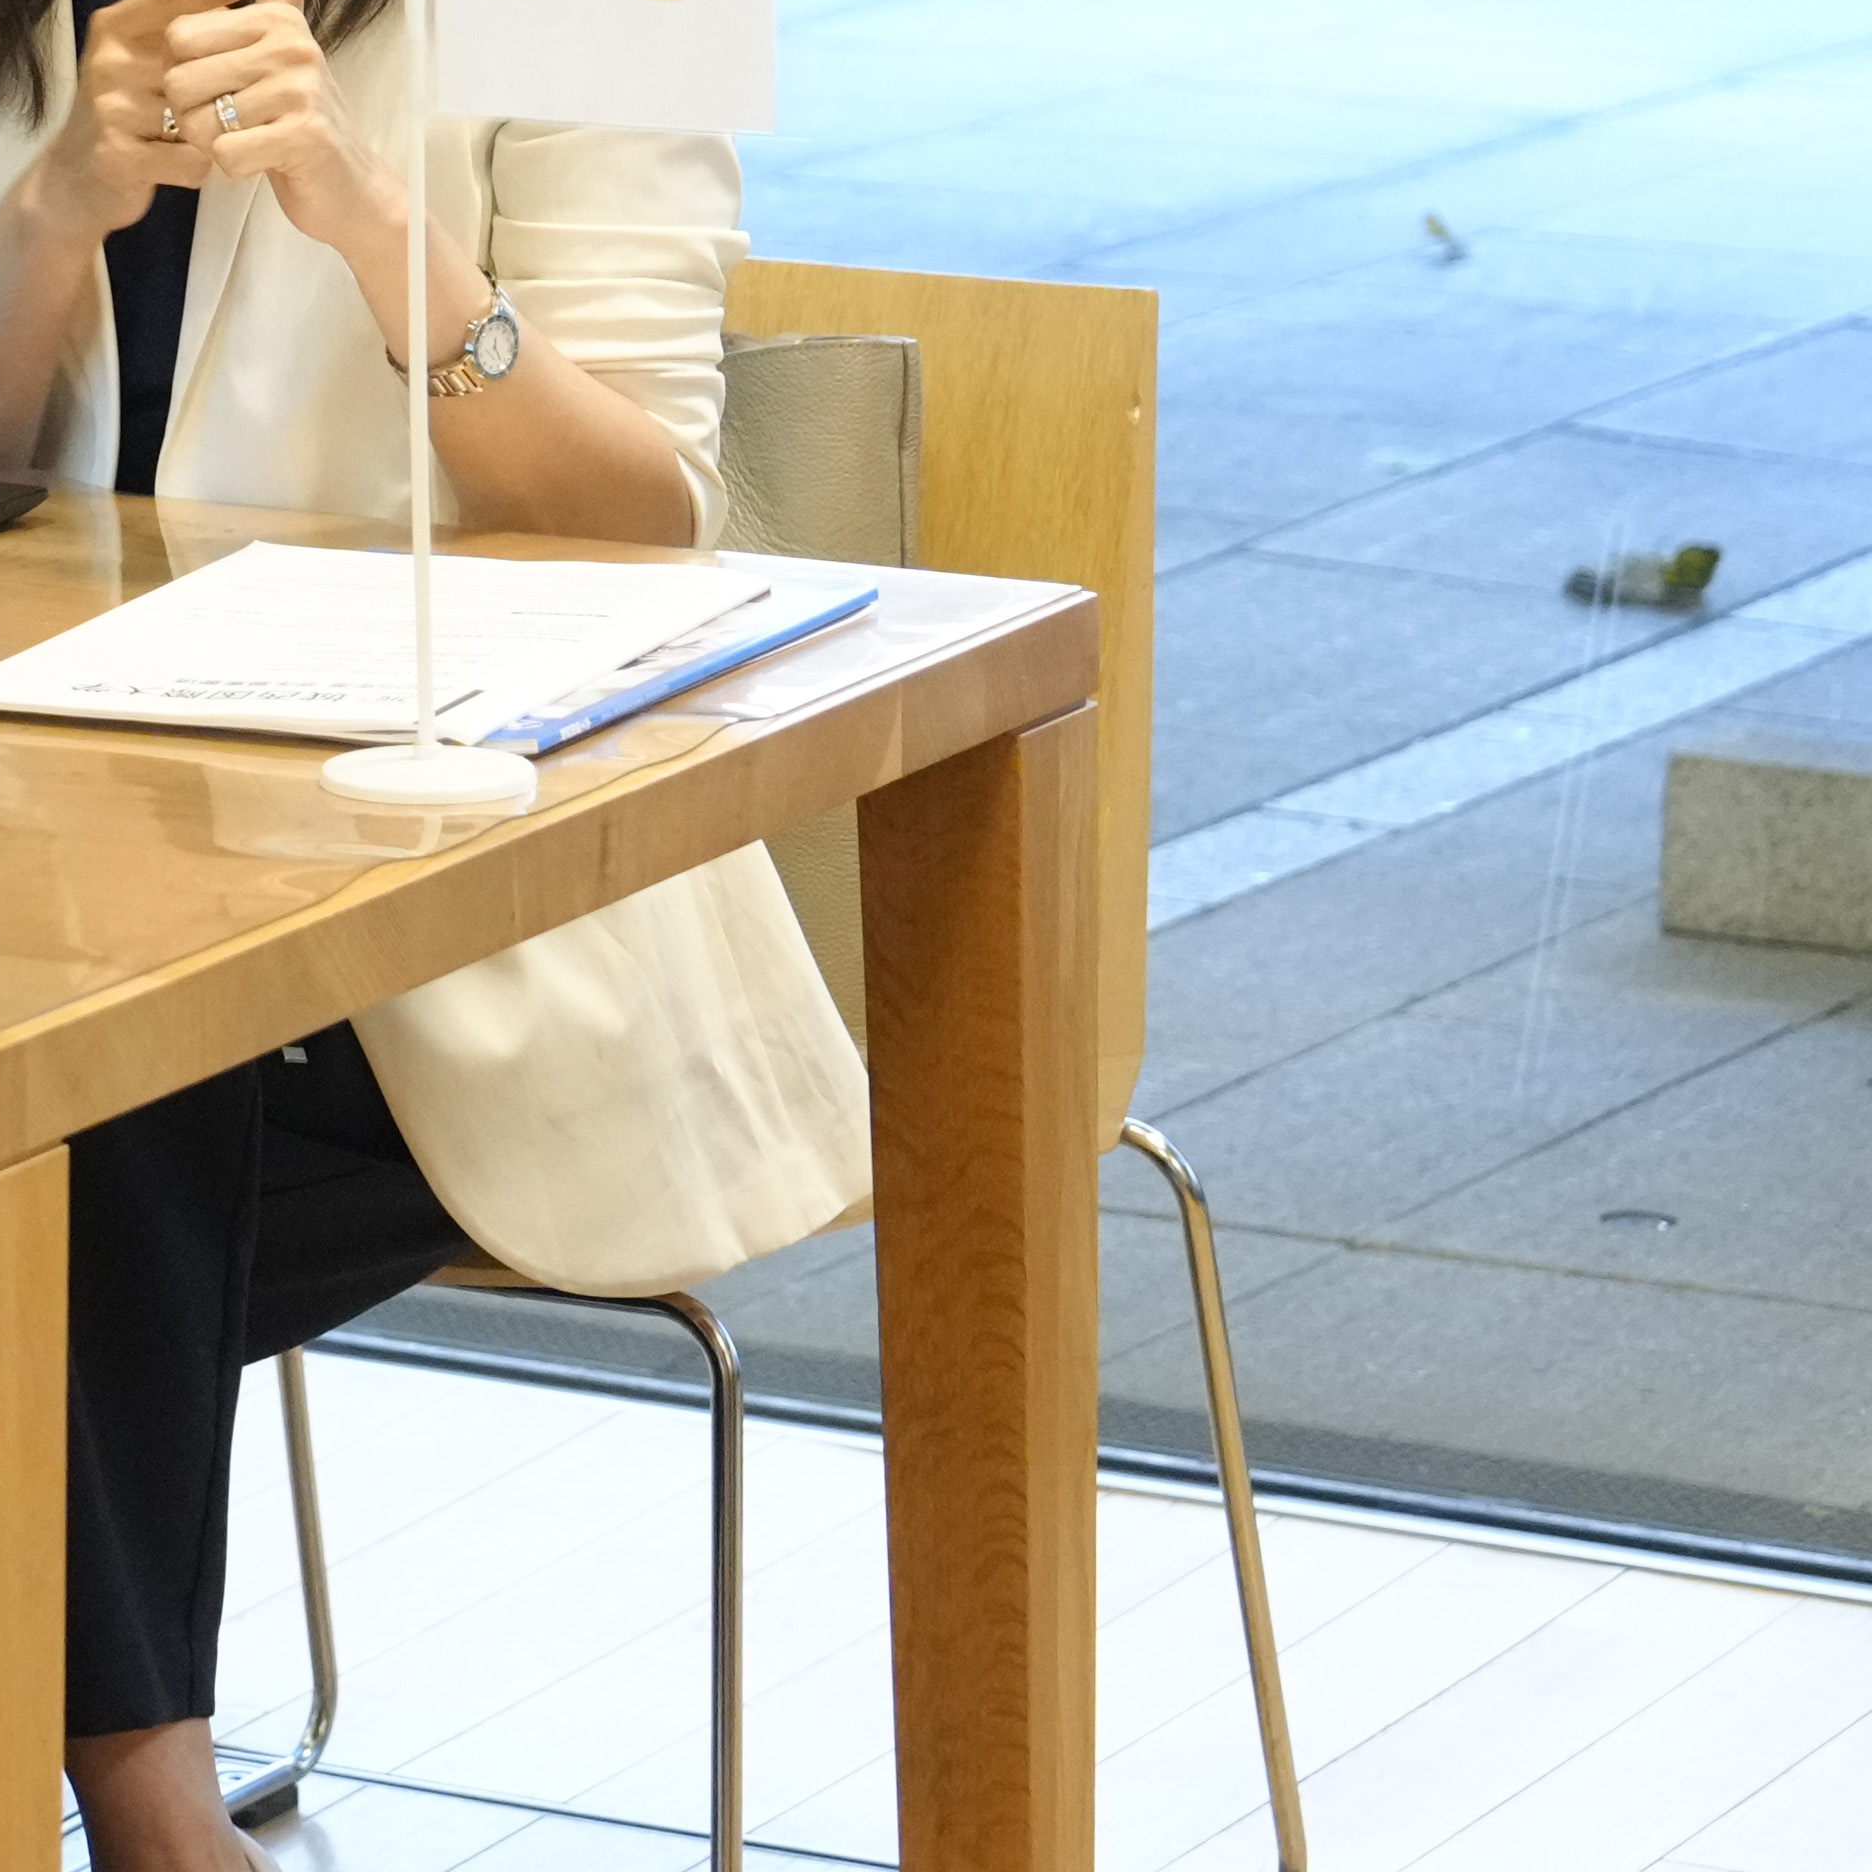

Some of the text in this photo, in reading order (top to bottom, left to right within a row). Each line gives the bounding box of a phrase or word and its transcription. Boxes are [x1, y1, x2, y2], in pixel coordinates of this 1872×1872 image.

[69, 682, 346, 702] 城西国際大学
